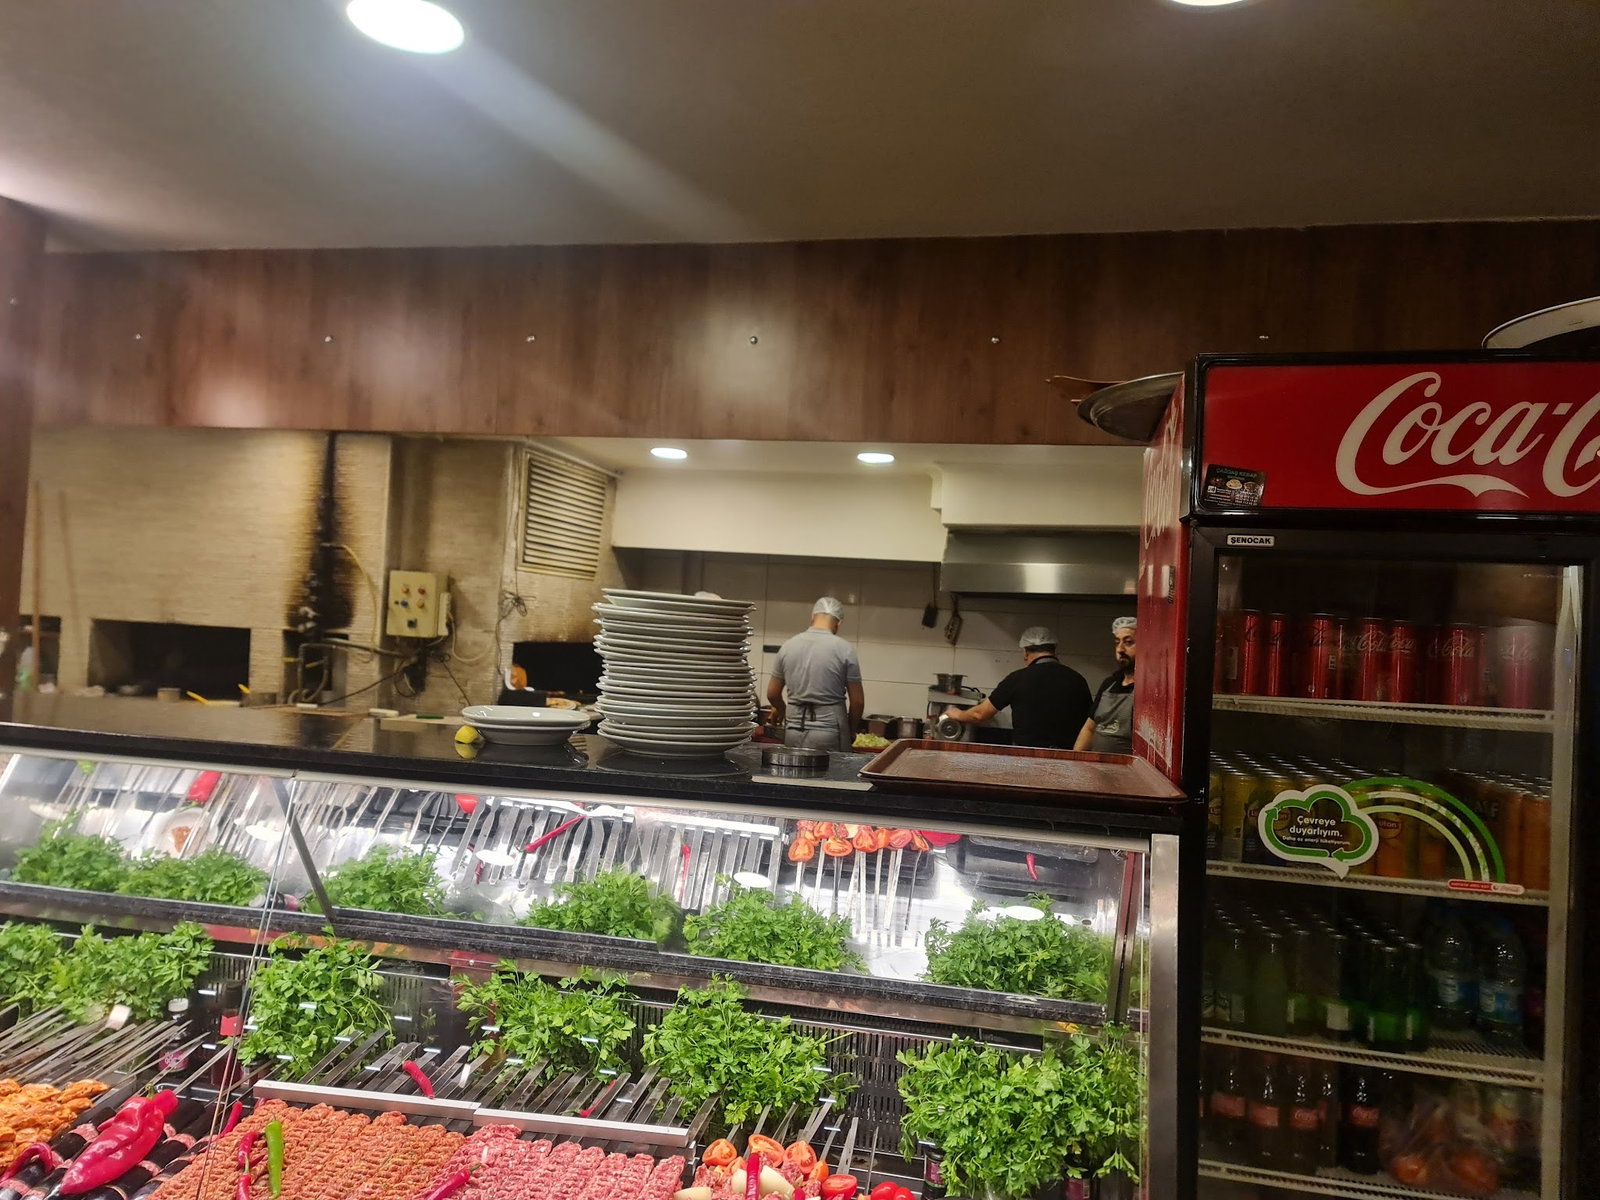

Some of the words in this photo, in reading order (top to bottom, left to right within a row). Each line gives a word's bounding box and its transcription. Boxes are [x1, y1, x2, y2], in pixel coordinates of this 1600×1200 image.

[1336, 371, 1600, 498] Coca-C
[1230, 537, 1271, 545] ŞENOCAK
[1297, 815, 1336, 827] Çevreye
[1289, 825, 1343, 838] duyarlıyım.
